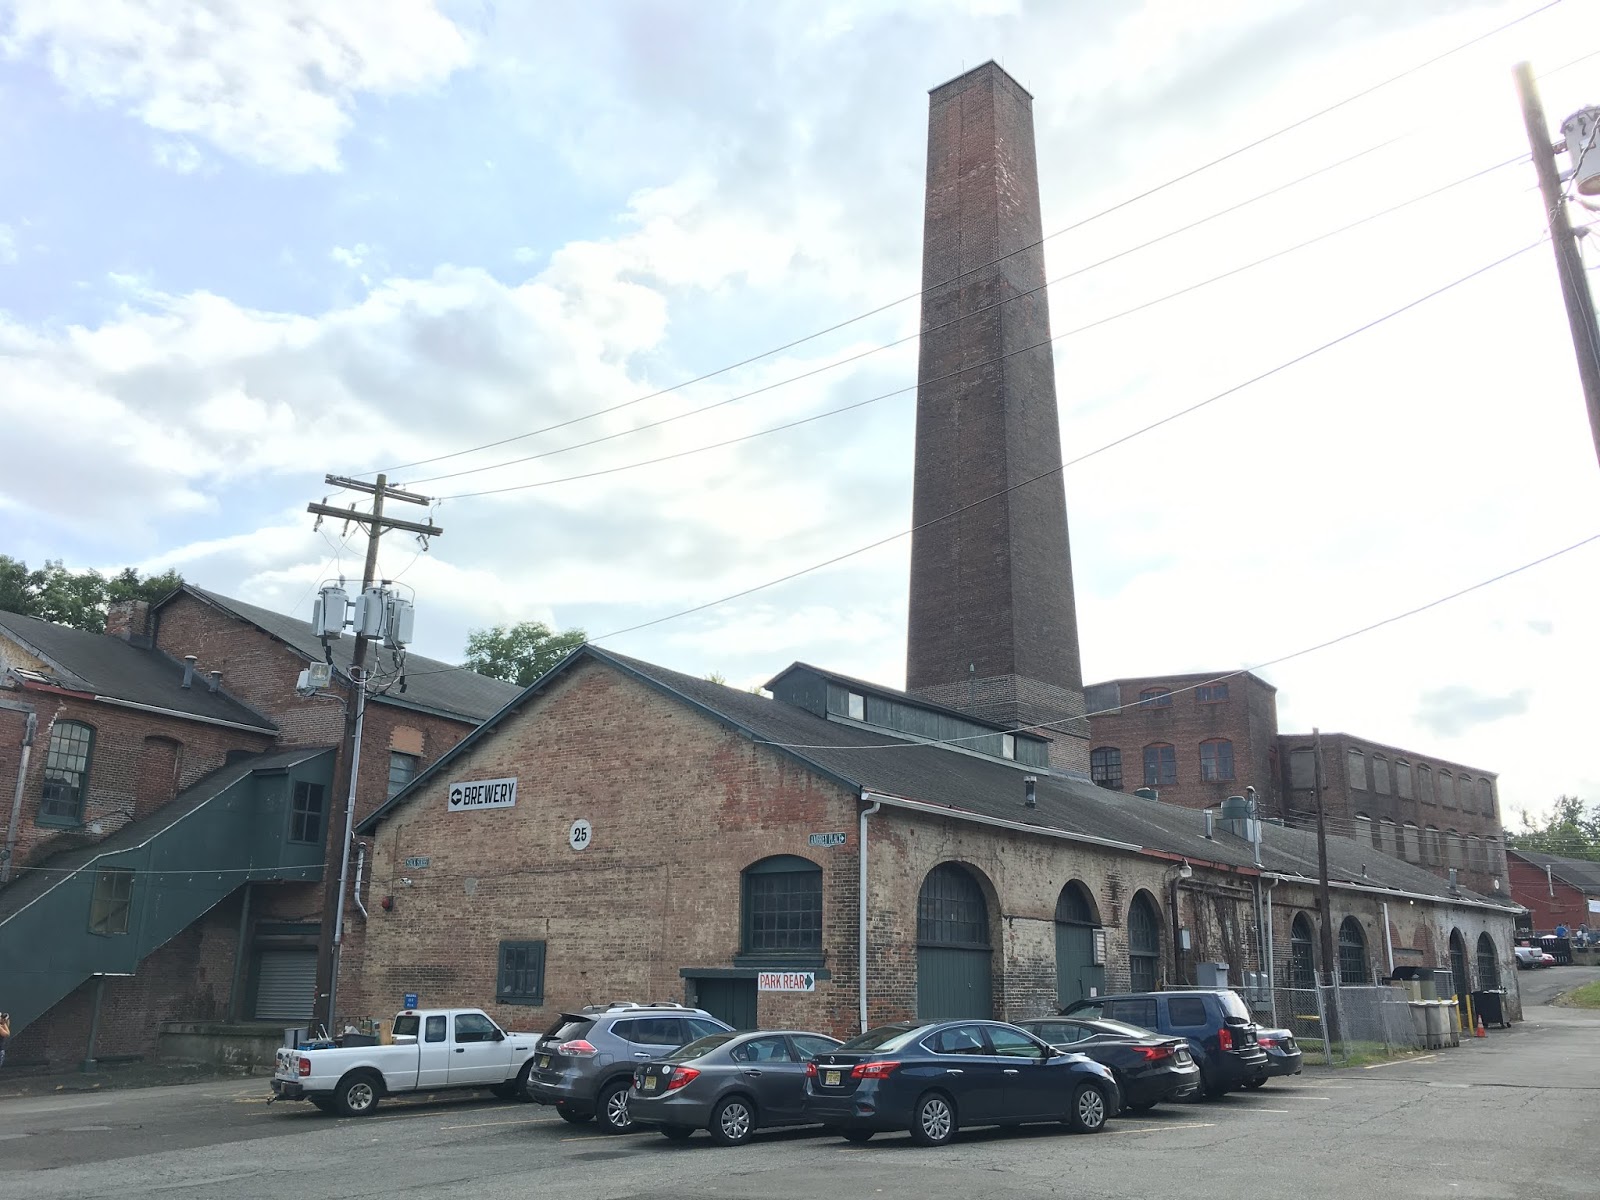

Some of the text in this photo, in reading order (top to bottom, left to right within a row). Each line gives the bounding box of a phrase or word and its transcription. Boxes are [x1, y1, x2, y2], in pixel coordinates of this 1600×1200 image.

[463, 782, 515, 806] BREWERY
[573, 827, 587, 842] 25
[760, 974, 805, 989] PARK REAR
